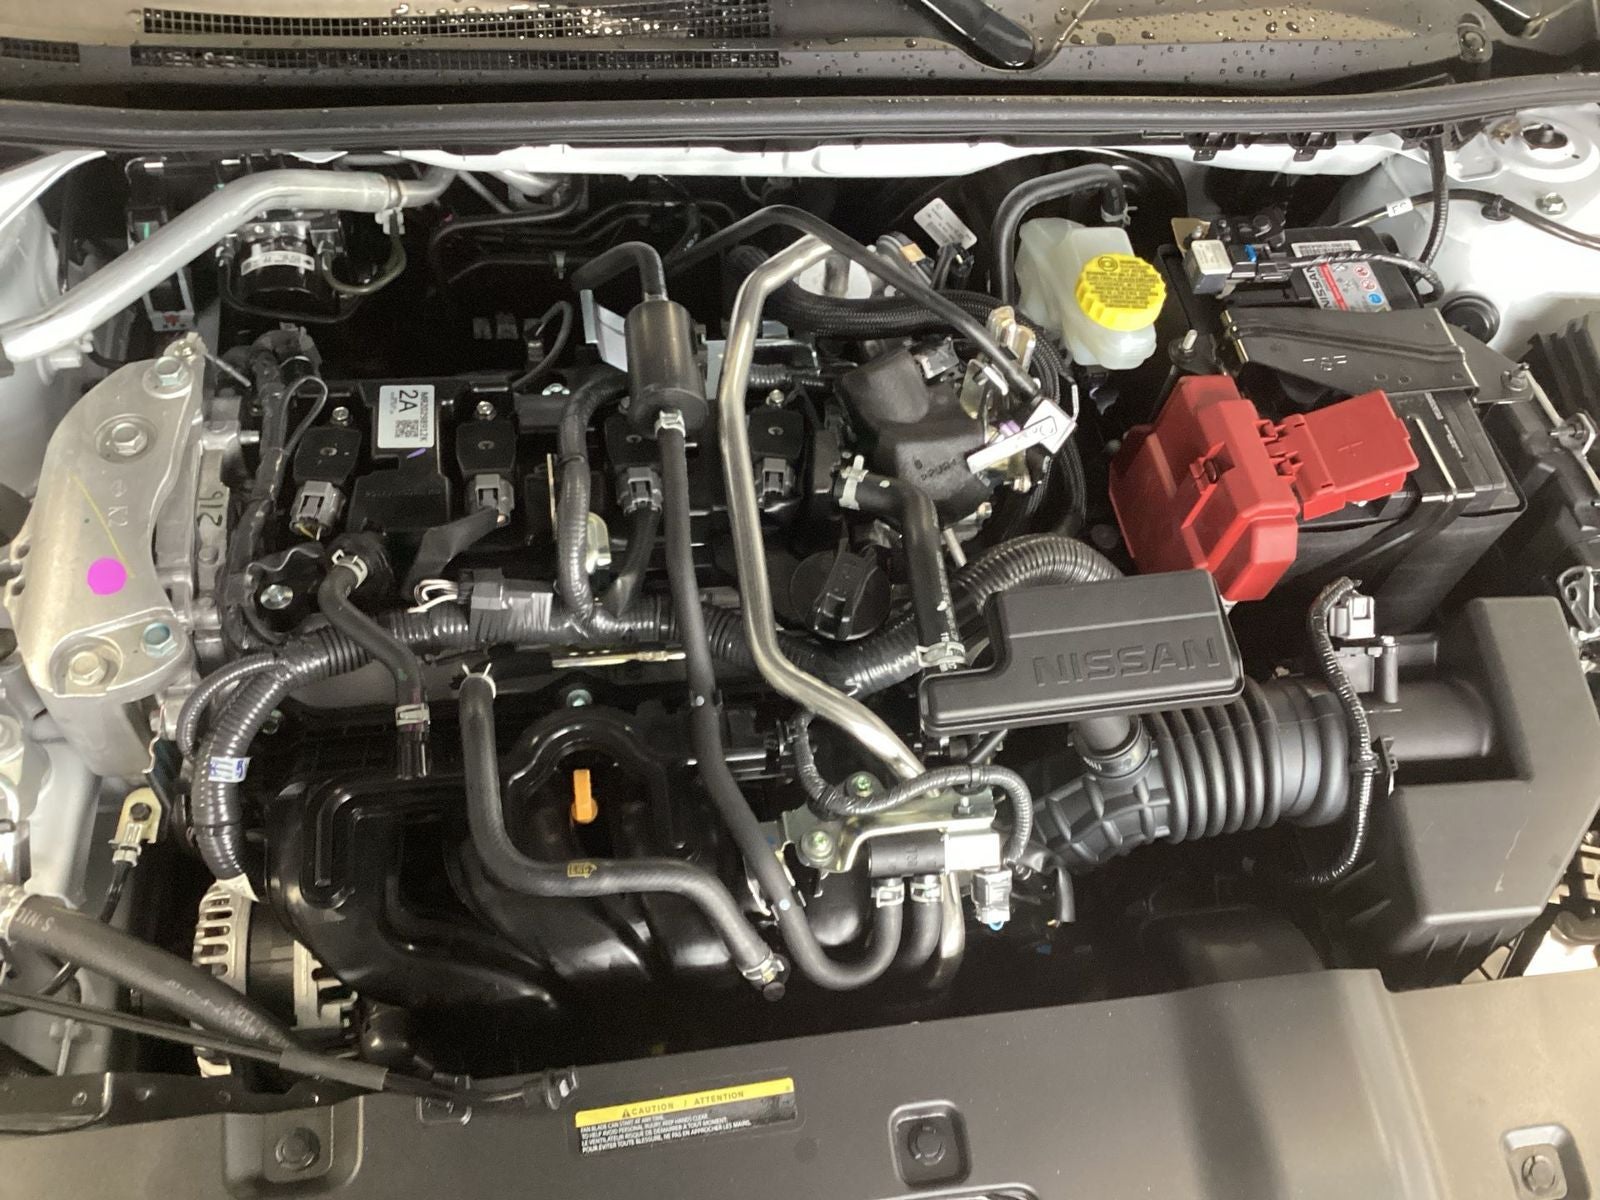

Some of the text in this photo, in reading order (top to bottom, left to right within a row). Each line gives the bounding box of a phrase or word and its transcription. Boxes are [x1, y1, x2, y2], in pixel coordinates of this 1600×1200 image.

[1305, 265, 1331, 309] NISSAN
[398, 389, 419, 413] 2A
[1033, 637, 1221, 687] NISSAN
[631, 1102, 674, 1115] CAUTION
[694, 1091, 744, 1105] ATTENTION
